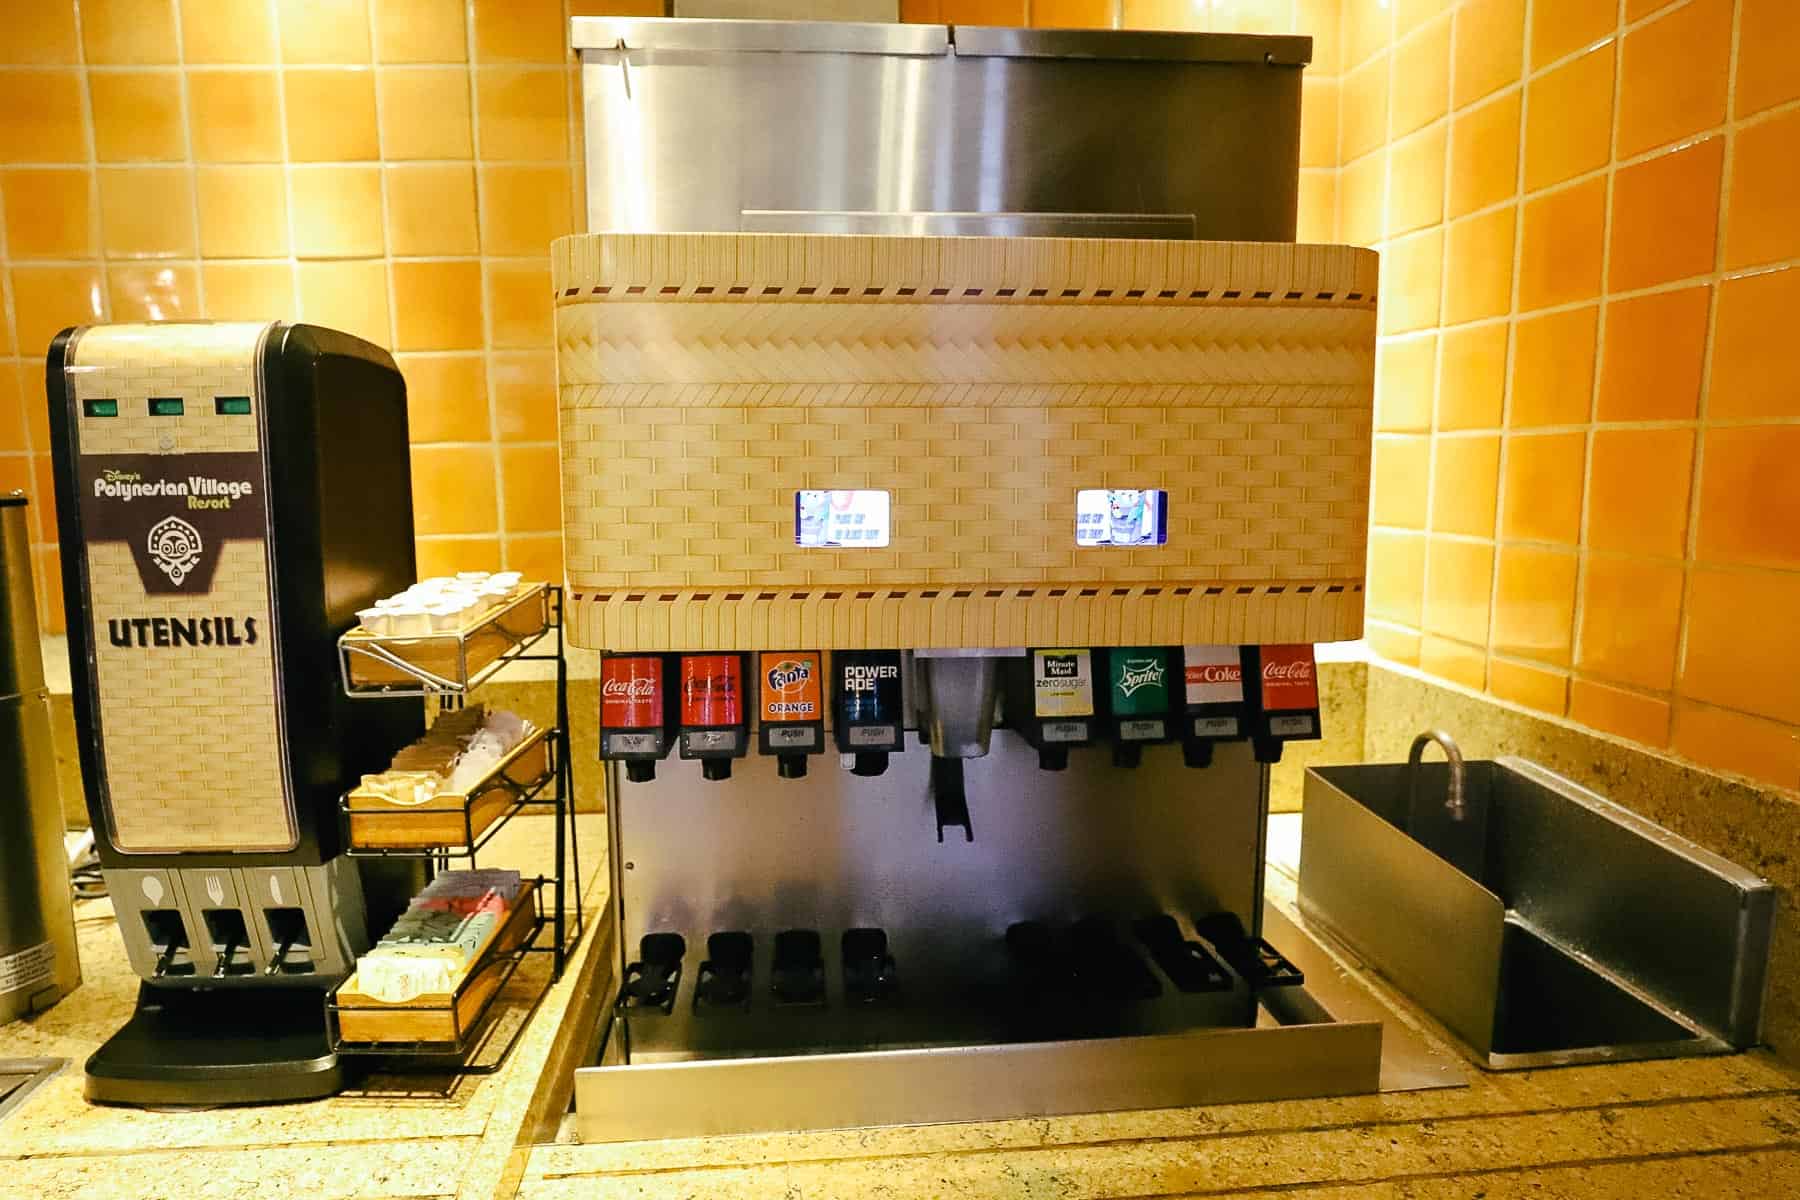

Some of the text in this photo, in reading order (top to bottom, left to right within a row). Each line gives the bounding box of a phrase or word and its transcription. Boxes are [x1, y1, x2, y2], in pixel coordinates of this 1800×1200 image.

[94, 476, 252, 502] Polynesian Village
[187, 496, 231, 509] Resort
[108, 617, 257, 648] UTENSILS
[1047, 660, 1076, 668] Minute
[768, 666, 809, 690] Fanta
[844, 666, 898, 679] POWER
[1051, 667, 1073, 676] Maid
[1204, 667, 1241, 682] Coke
[844, 679, 876, 692] ADE
[1123, 670, 1159, 688] Sprite
[768, 702, 814, 714] ORANGE
